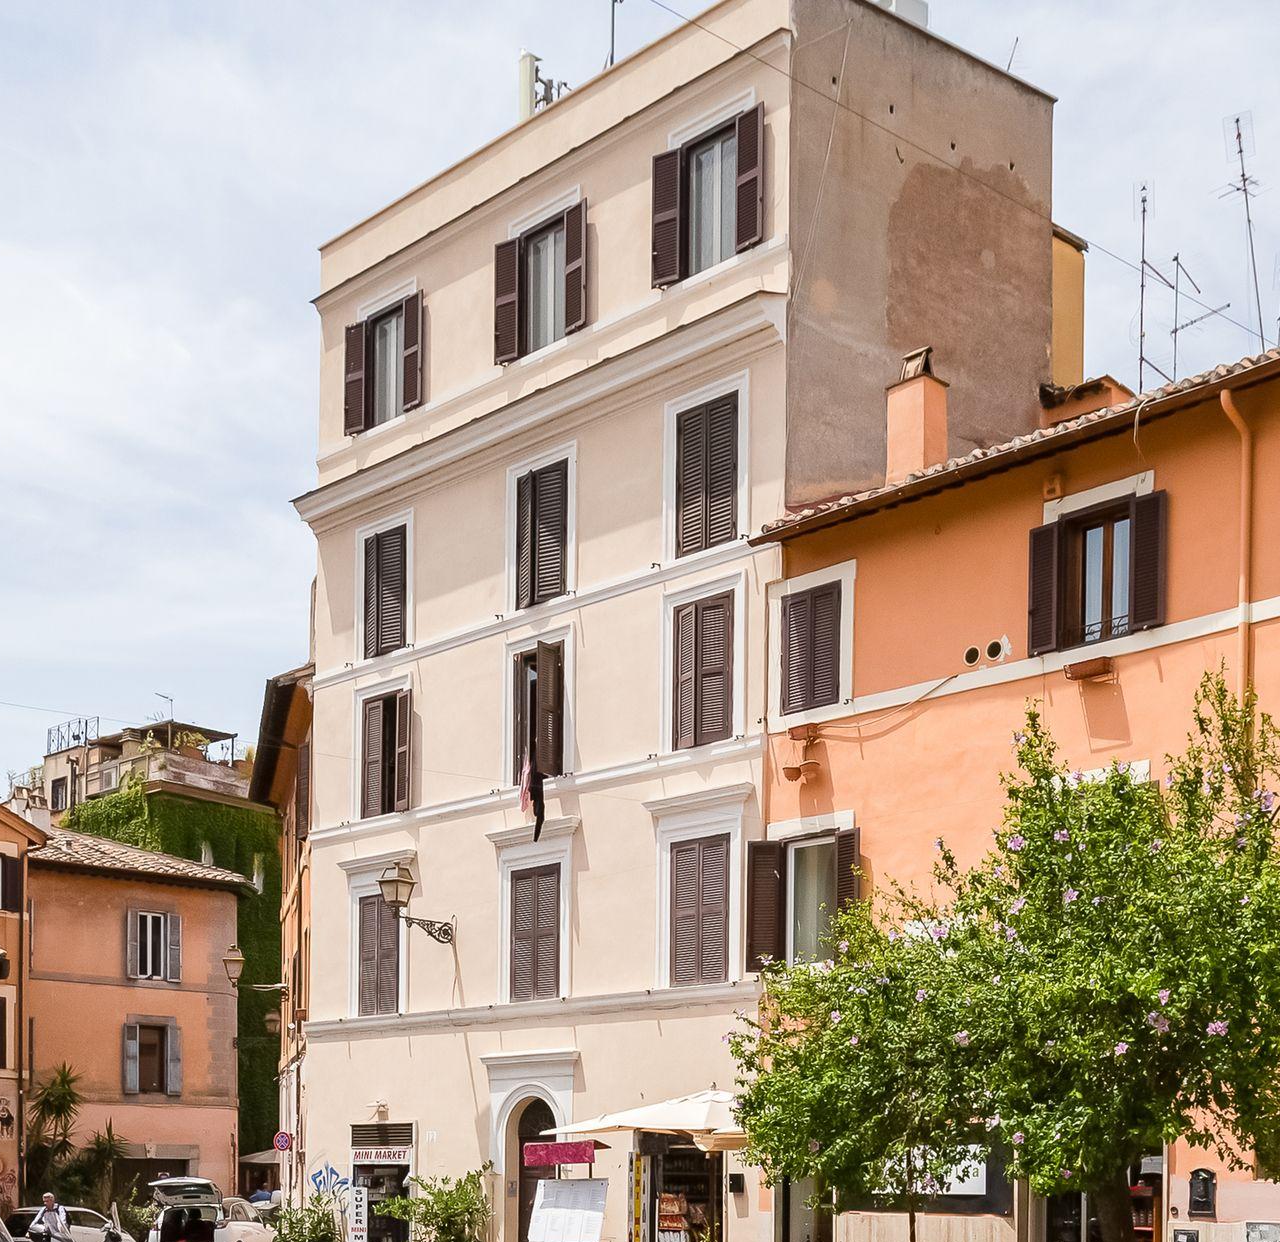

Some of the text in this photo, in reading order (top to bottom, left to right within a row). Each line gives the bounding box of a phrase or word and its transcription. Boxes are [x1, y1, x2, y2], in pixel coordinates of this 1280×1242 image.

[354, 1150, 407, 1160] MINI MARKET
[354, 1189, 363, 1225] SUPER
